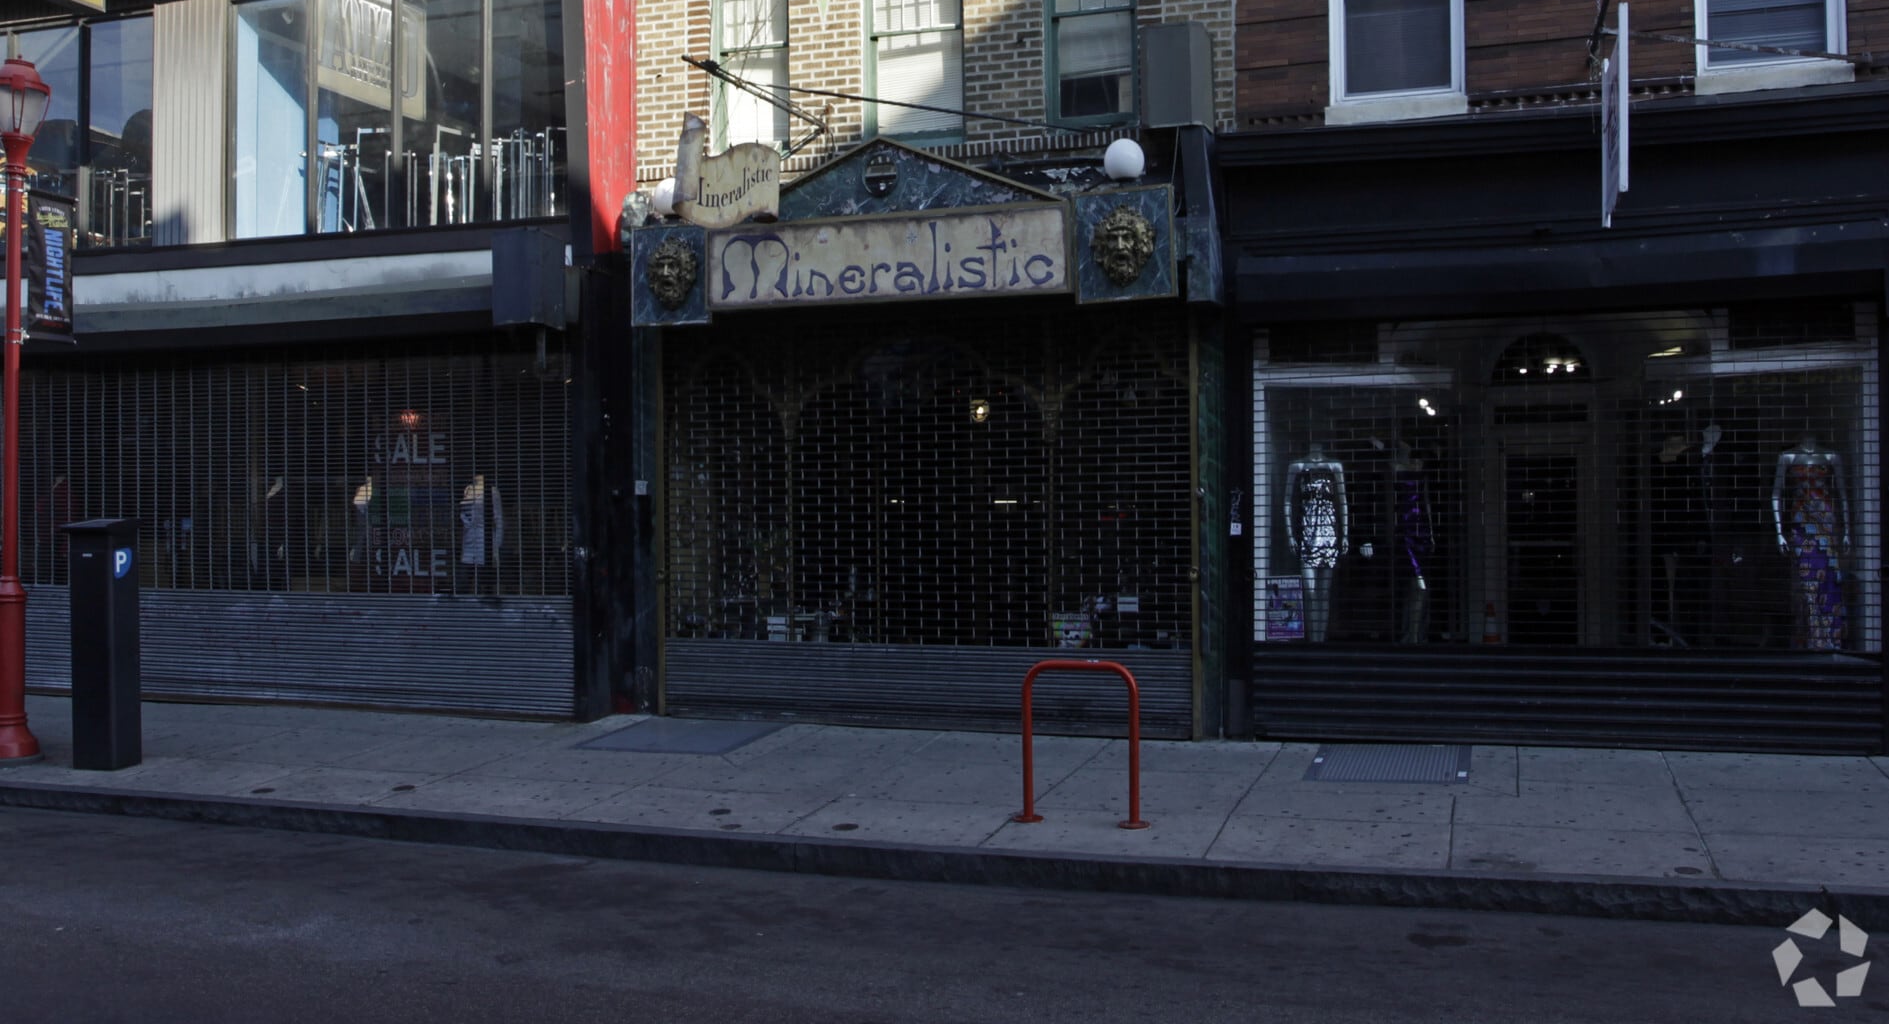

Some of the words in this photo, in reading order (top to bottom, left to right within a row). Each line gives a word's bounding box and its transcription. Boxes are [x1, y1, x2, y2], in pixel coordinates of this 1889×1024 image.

[696, 160, 773, 208] ineralistic
[721, 218, 1055, 299] Mineralistic
[373, 433, 448, 465] SALE
[116, 551, 127, 573] P
[375, 548, 448, 577] SALE
